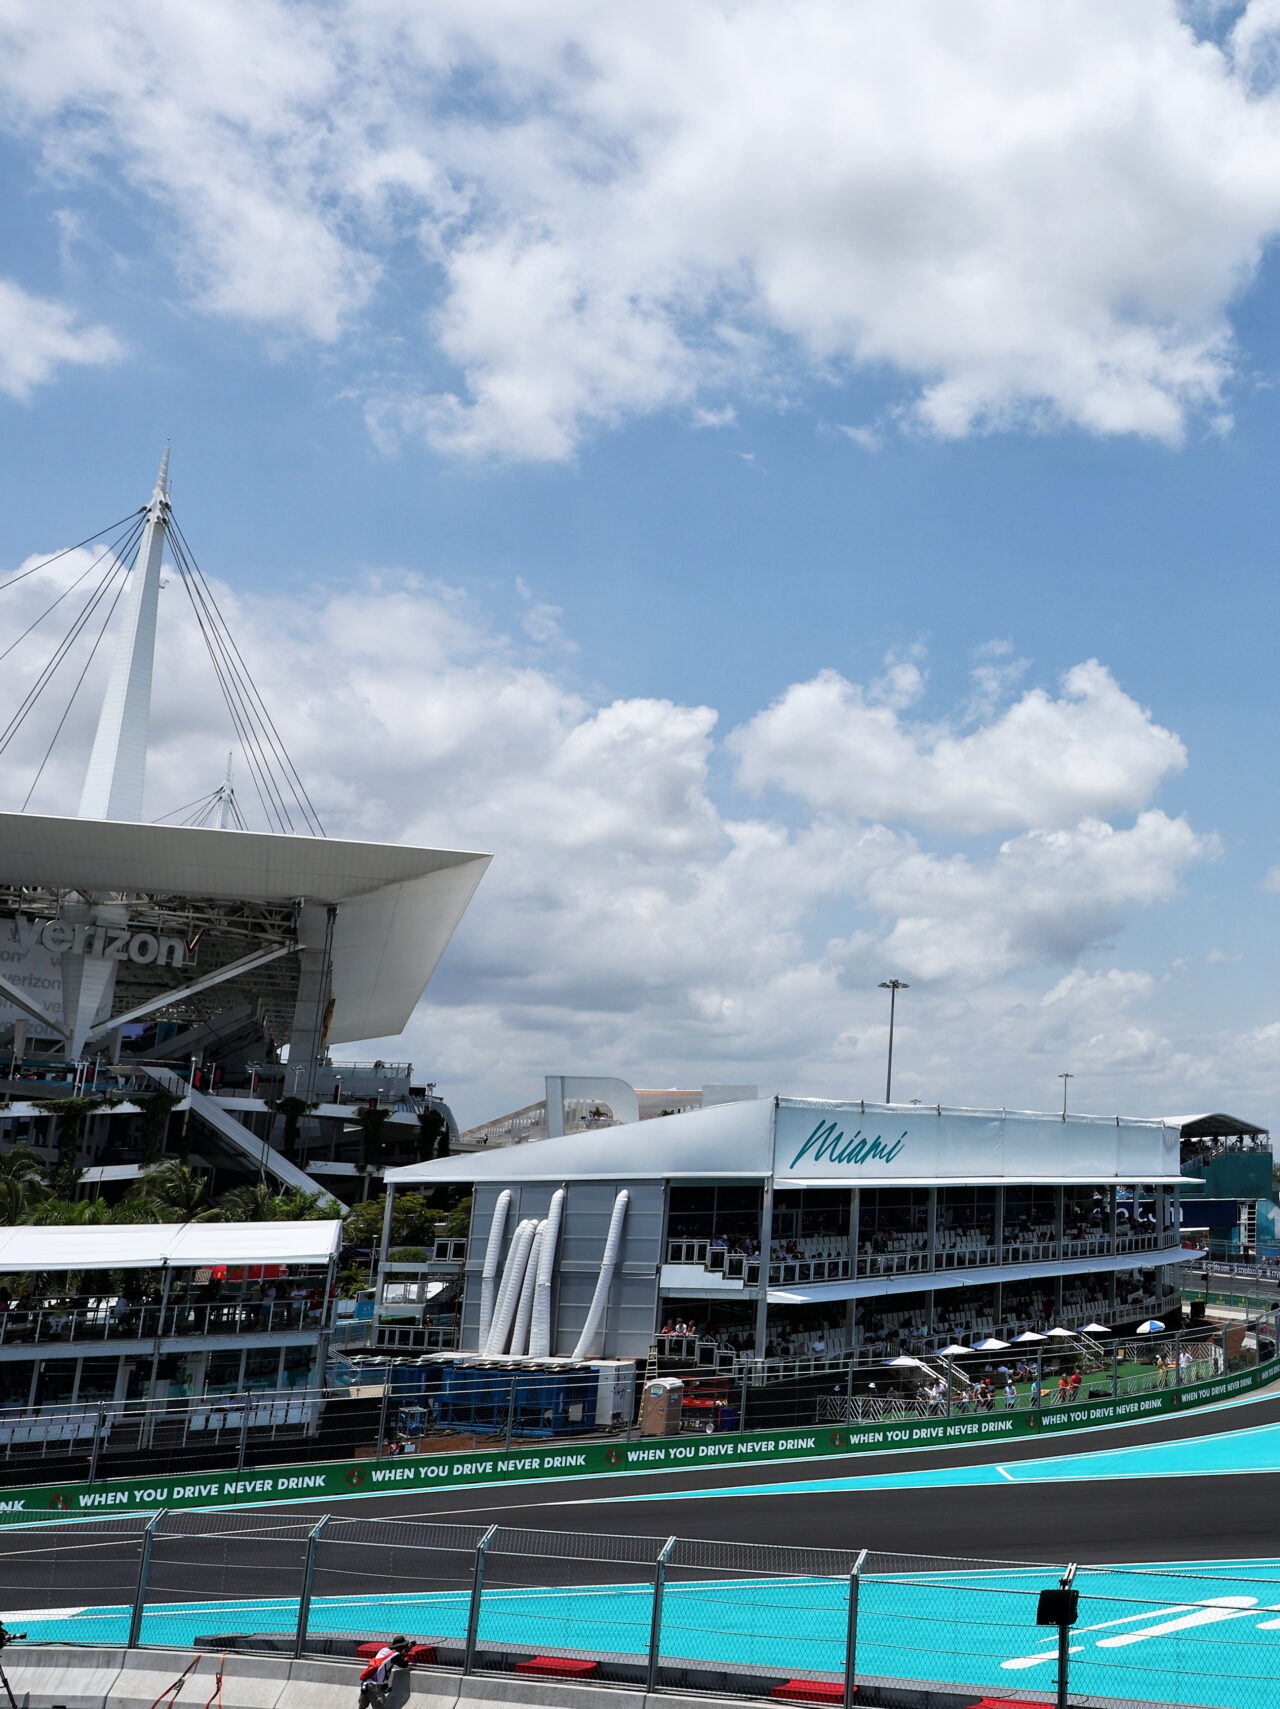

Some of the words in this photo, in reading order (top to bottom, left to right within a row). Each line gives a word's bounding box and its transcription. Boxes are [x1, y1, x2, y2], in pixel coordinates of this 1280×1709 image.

[15, 915, 185, 968] verizon
[789, 1119, 908, 1170] Miami
[1181, 1391, 1198, 1403] WHEN
[1199, 1389, 1210, 1399] YOU
[1211, 1385, 1226, 1396] DRIVE
[1227, 1381, 1240, 1392] NEVER
[1042, 1413, 1068, 1427] WHEN
[1070, 1410, 1088, 1423] YOU
[1090, 1406, 1114, 1419] DRIVE
[1116, 1402, 1139, 1415] NEVER
[1140, 1398, 1162, 1411] DRINK
[850, 1432, 884, 1445] WHEN
[886, 1429, 910, 1441] YOU
[912, 1426, 944, 1439] DRIVE
[946, 1423, 979, 1437] NEVER
[981, 1420, 1013, 1433] DRINK
[627, 1448, 666, 1463] WHEN
[668, 1446, 695, 1459] YOU
[698, 1443, 734, 1457] DRIVE
[737, 1440, 775, 1454] NEVER
[778, 1437, 816, 1451] DRINK
[371, 1467, 415, 1483] WHEN
[419, 1464, 450, 1479] YOU
[452, 1461, 494, 1476] DRIVE
[497, 1458, 541, 1473] NEVER
[543, 1454, 587, 1469] DRINK
[79, 1491, 128, 1508] WHEN
[134, 1488, 168, 1504] YOU
[173, 1483, 219, 1499] DRIVE
[224, 1479, 273, 1495] NEVER
[277, 1474, 326, 1490] DRINK
